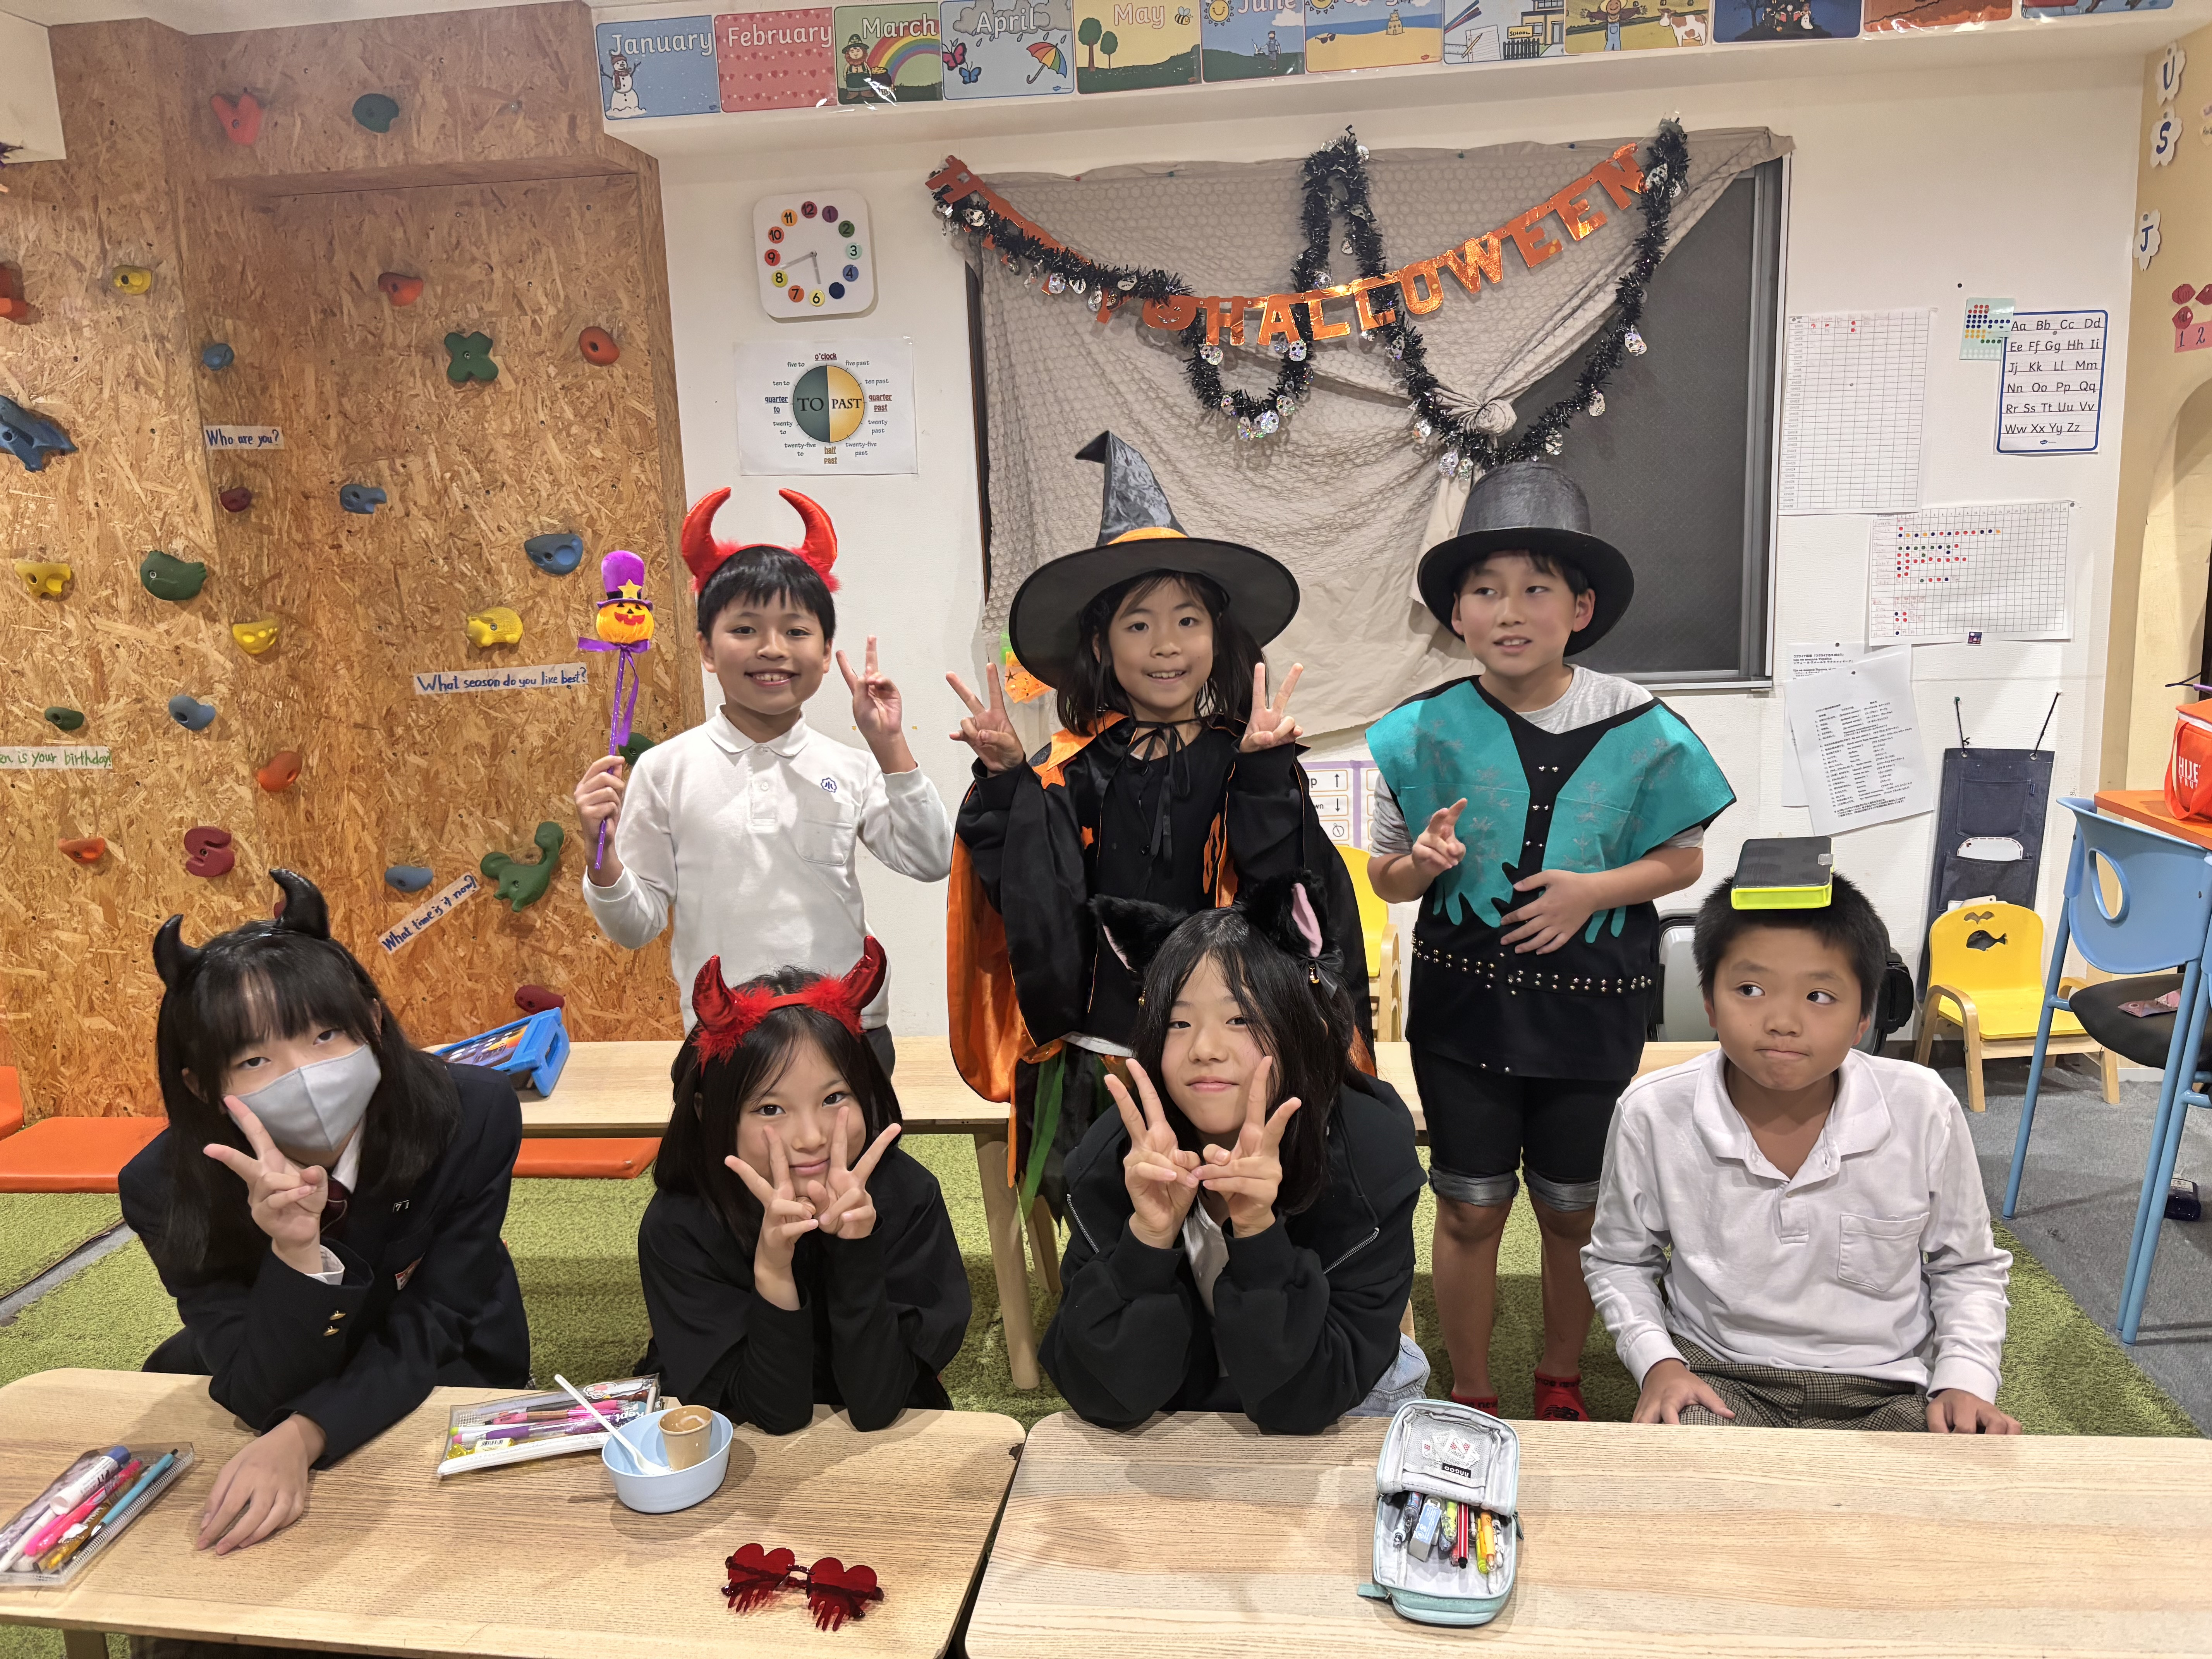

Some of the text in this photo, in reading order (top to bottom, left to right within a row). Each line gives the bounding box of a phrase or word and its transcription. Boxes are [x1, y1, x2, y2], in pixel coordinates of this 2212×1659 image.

[976, 7, 1036, 38] April
[1114, 3, 1164, 29] May
[862, 14, 936, 40] March
[727, 23, 833, 48] February
[609, 32, 715, 57] January
[2164, 55, 2175, 90] U
[2156, 121, 2171, 154] S
[802, 204, 814, 215] 12
[827, 209, 831, 220] 1
[784, 212, 792, 223] 11
[843, 223, 850, 234] 2
[769, 230, 781, 241] 10
[2140, 225, 2154, 252] J
[850, 245, 857, 256] 3
[1204, 143, 1645, 346] HALLOWEEN
[768, 252, 775, 263] 9
[776, 272, 783, 283] 8
[846, 268, 853, 278] 4
[792, 289, 799, 300] 7
[812, 293, 820, 304] 6
[2011, 318, 2100, 331] Aa Bb Cc Dd
[2196, 327, 2205, 345] 2
[2010, 339, 2099, 354] Ee Ff Gg Hh Ii
[2008, 361, 2097, 374] Jj Kk Ll Mm
[2007, 381, 2095, 393] Nn Oo Pp Qq
[797, 397, 862, 411] TO PAST
[2006, 402, 2094, 413] Rr Ss Tt Uu Vv
[2005, 422, 2080, 434] Ww Xx Yy Zz
[206, 428, 279, 447] Who are you?
[417, 667, 587, 692] What season do you like best?
[0, 754, 13, 764] en
[18, 751, 27, 763] is
[32, 752, 57, 767] your
[2179, 756, 2201, 783] HIJE
[1309, 778, 1317, 788] p
[382, 875, 476, 951] What time is it now?
[615, 1412, 644, 1422] Kept
